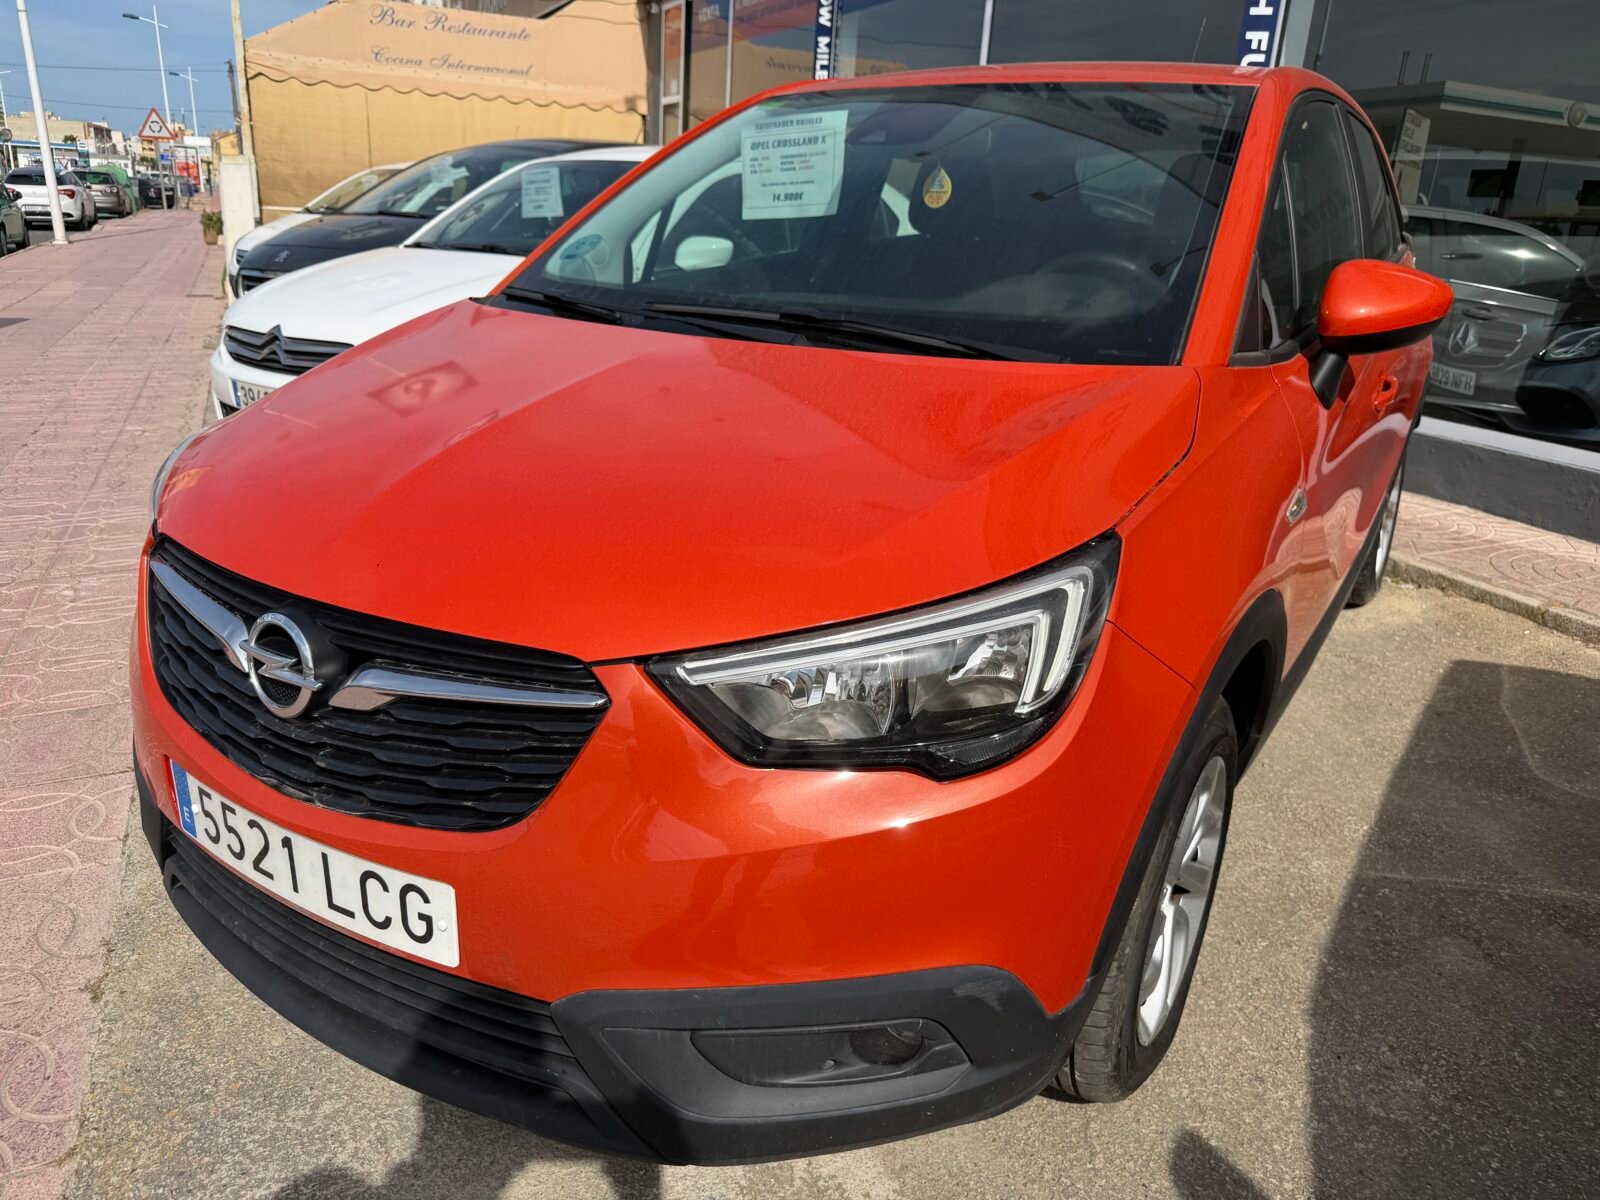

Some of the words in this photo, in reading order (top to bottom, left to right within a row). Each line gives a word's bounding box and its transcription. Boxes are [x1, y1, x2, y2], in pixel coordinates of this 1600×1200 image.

[369, 4, 416, 29] Bar
[424, 11, 532, 42] Restaurante
[371, 45, 423, 67] Cocina
[430, 54, 533, 76] Internacional
[750, 141, 770, 151] OPEL
[772, 136, 819, 149] CROSSLAND
[821, 135, 827, 144] X
[197, 785, 299, 894] 5521
[321, 851, 434, 944] LCG
